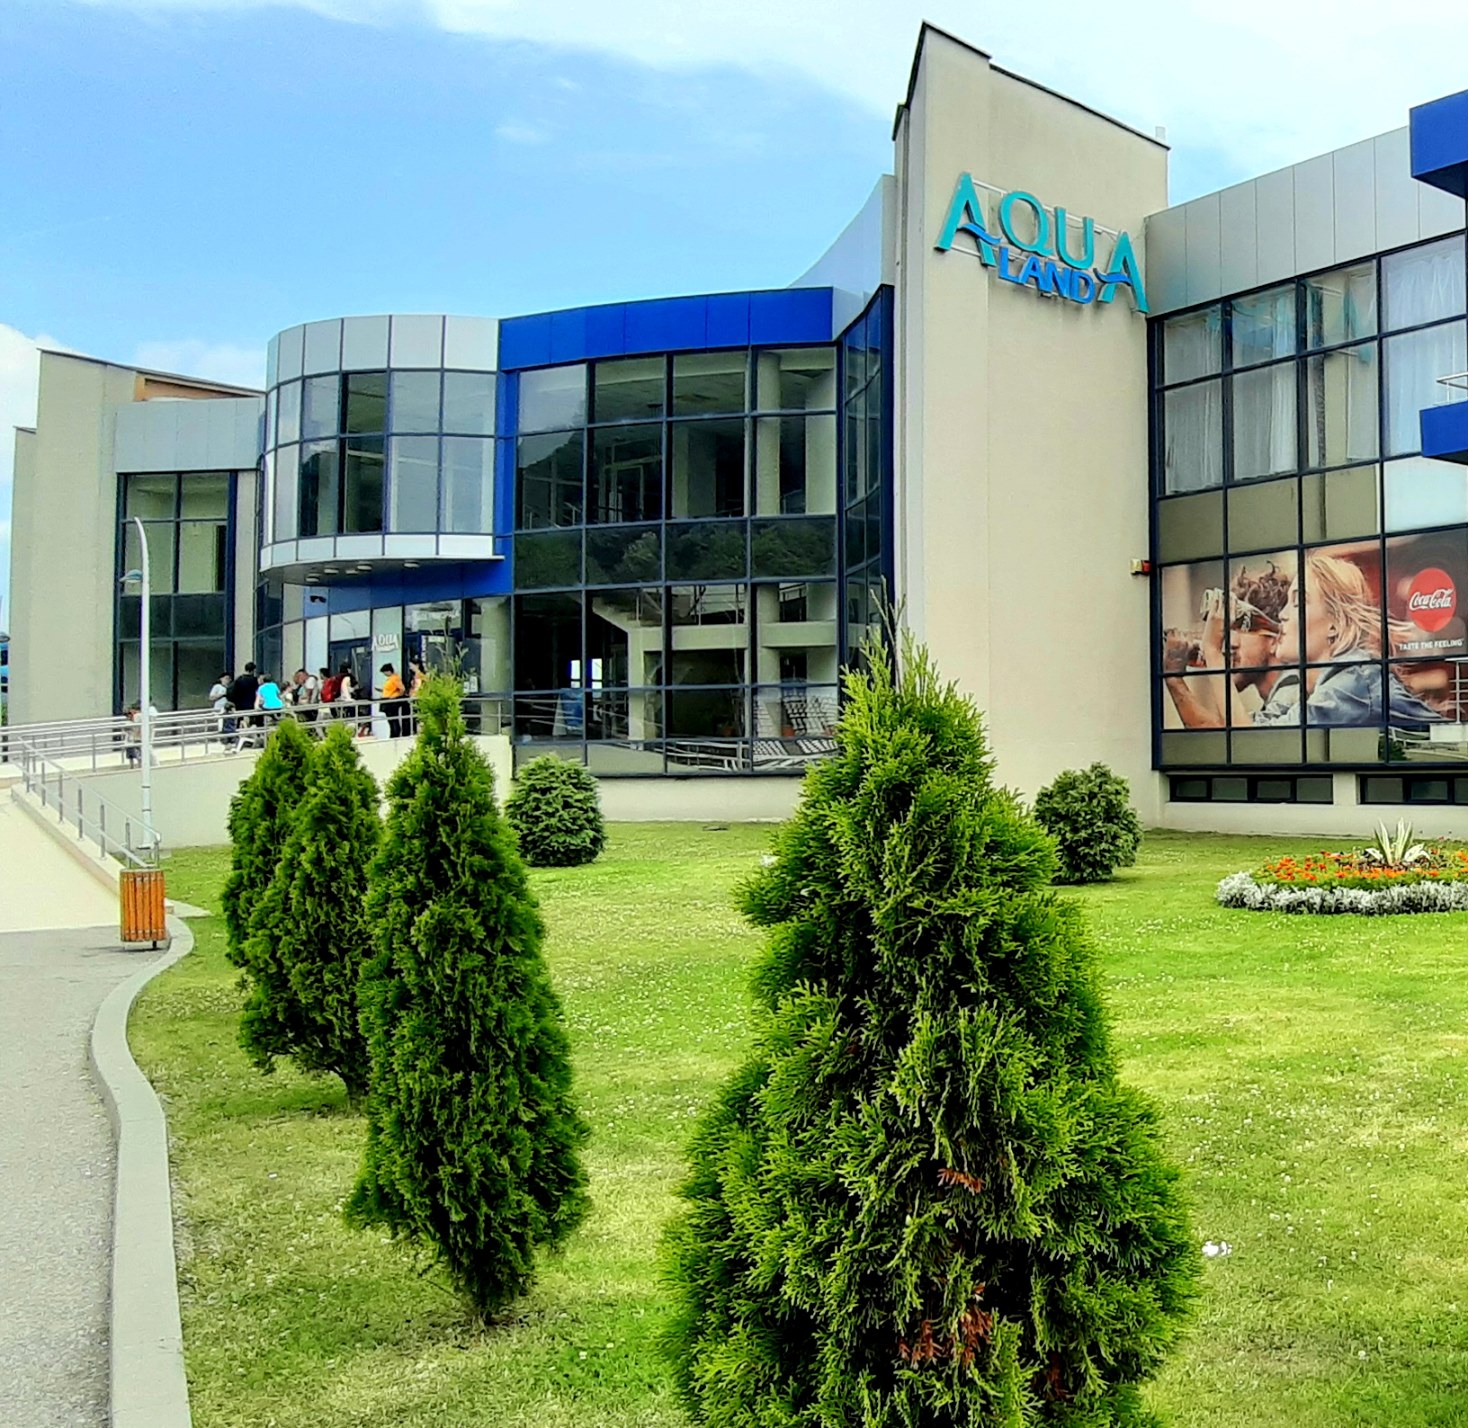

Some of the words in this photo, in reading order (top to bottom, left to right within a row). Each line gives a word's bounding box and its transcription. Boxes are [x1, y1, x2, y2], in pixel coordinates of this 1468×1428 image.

[934, 172, 1149, 313] AQUA
[998, 247, 1096, 304] LAND
[1399, 642, 1419, 651] TASTE
[1420, 641, 1433, 649] THE
